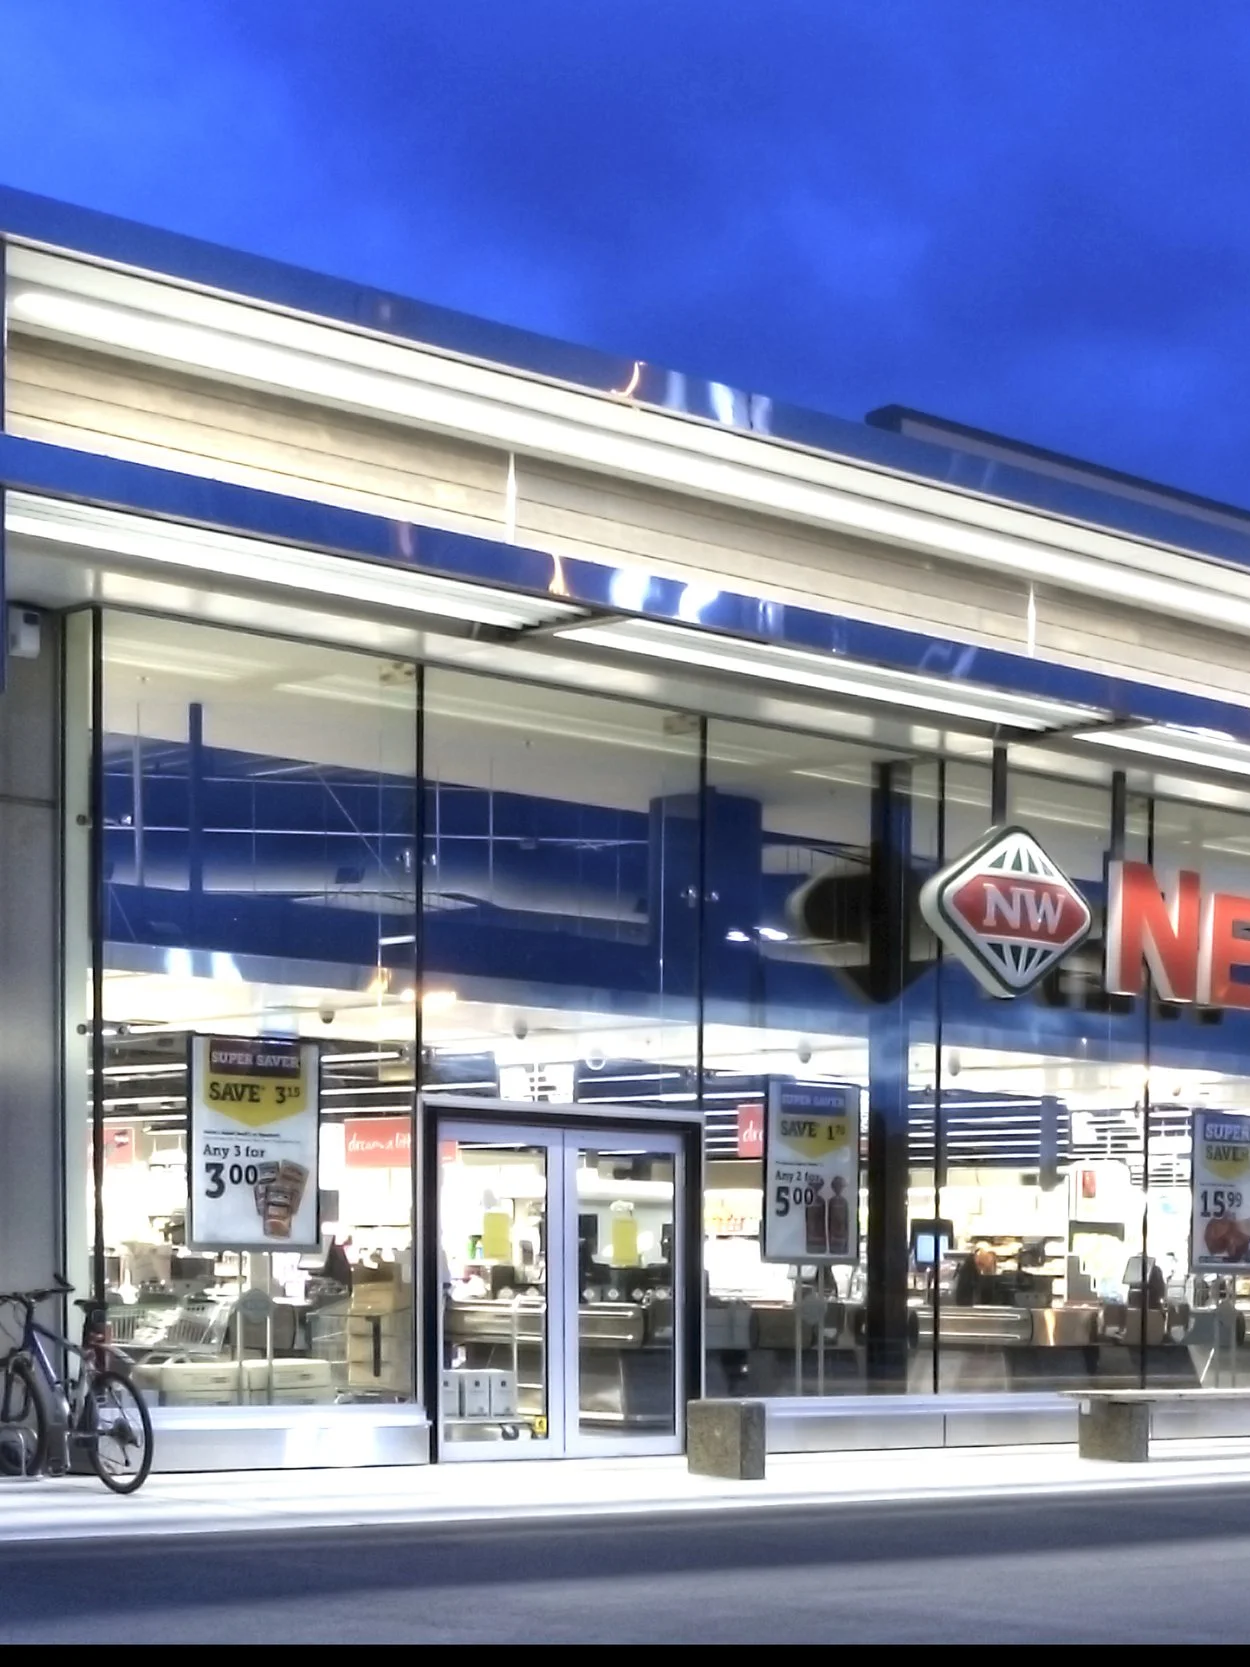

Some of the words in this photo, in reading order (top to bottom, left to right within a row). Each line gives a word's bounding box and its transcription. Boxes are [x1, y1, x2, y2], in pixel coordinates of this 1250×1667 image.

[982, 883, 1066, 934] NW
[211, 1051, 253, 1065] SUPER
[256, 1054, 300, 1069] SAVER
[780, 1119, 817, 1138] SAVE
[1205, 1123, 1250, 1142] SUPER
[203, 1144, 229, 1159] Any
[233, 1145, 242, 1157] 3
[245, 1146, 266, 1158] for
[1206, 1145, 1249, 1162] SAVER
[775, 1170, 794, 1184] Any
[796, 1171, 804, 1182] 2
